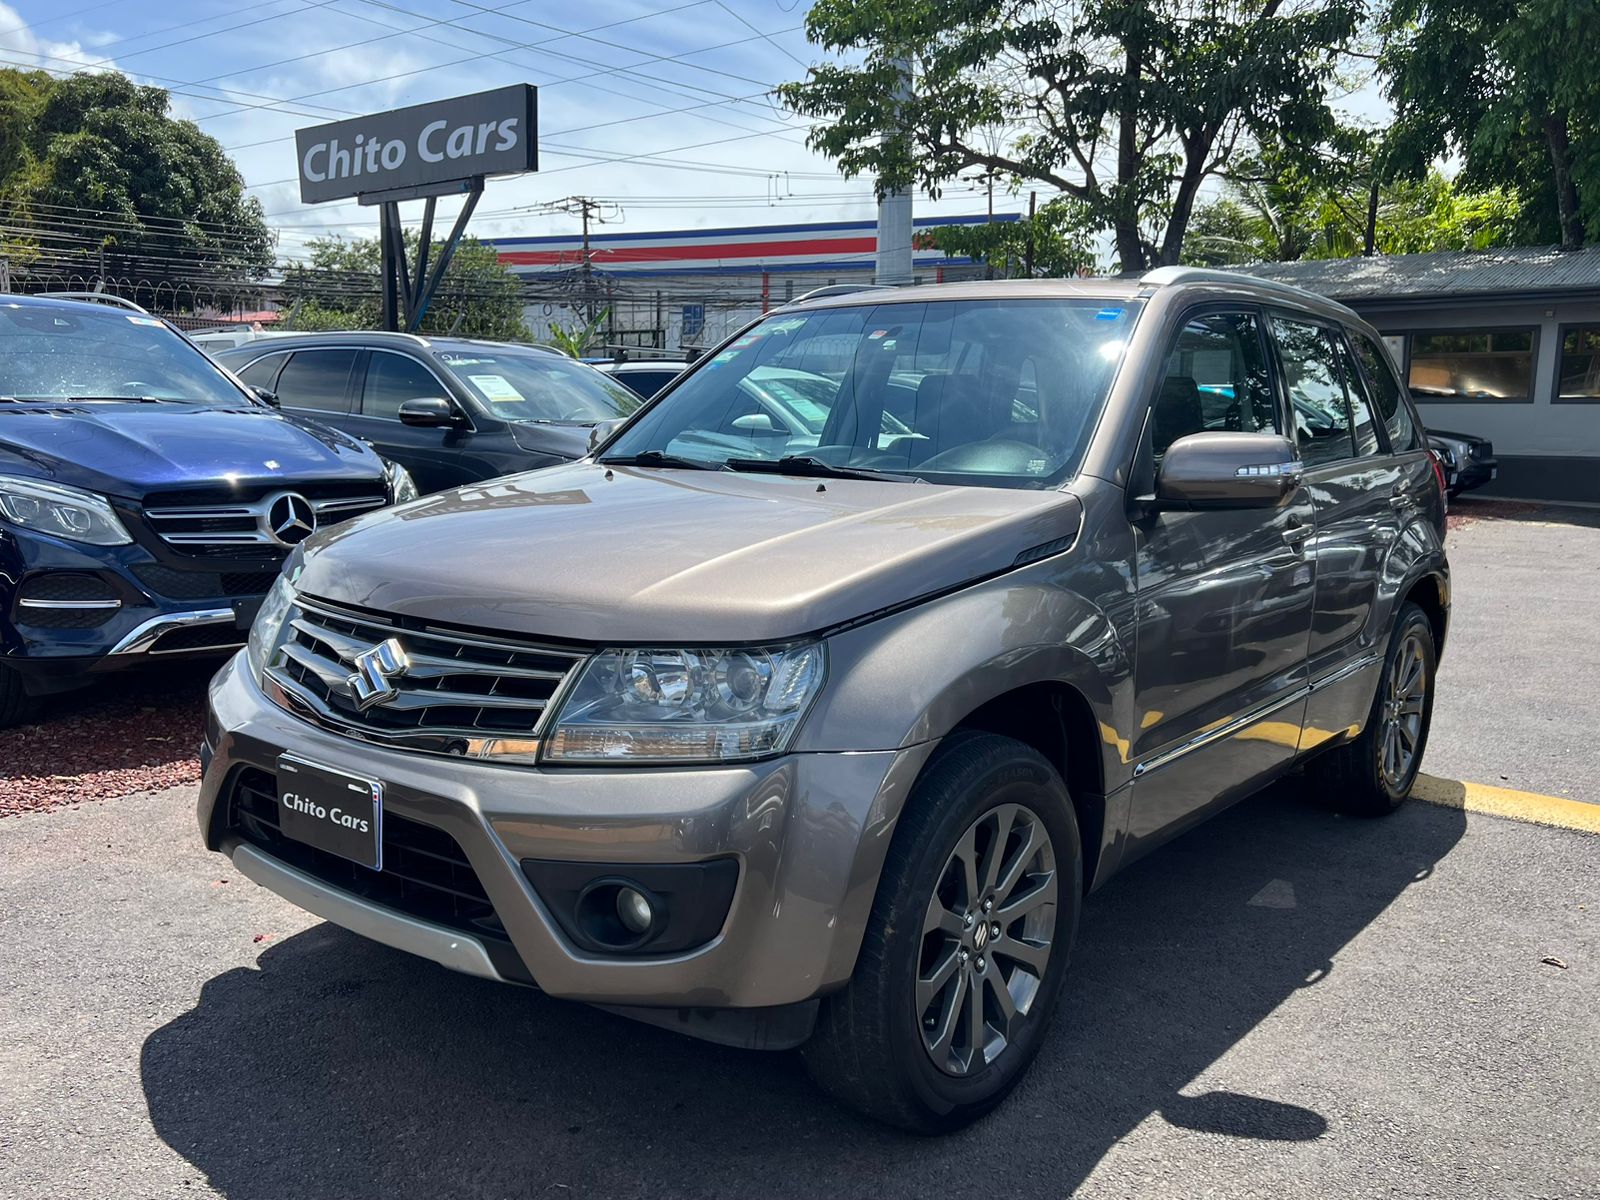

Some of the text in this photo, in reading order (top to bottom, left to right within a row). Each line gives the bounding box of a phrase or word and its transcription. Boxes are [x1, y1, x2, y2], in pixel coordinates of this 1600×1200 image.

[303, 118, 519, 182] Chito Cars
[283, 793, 369, 832] Chito Cars
